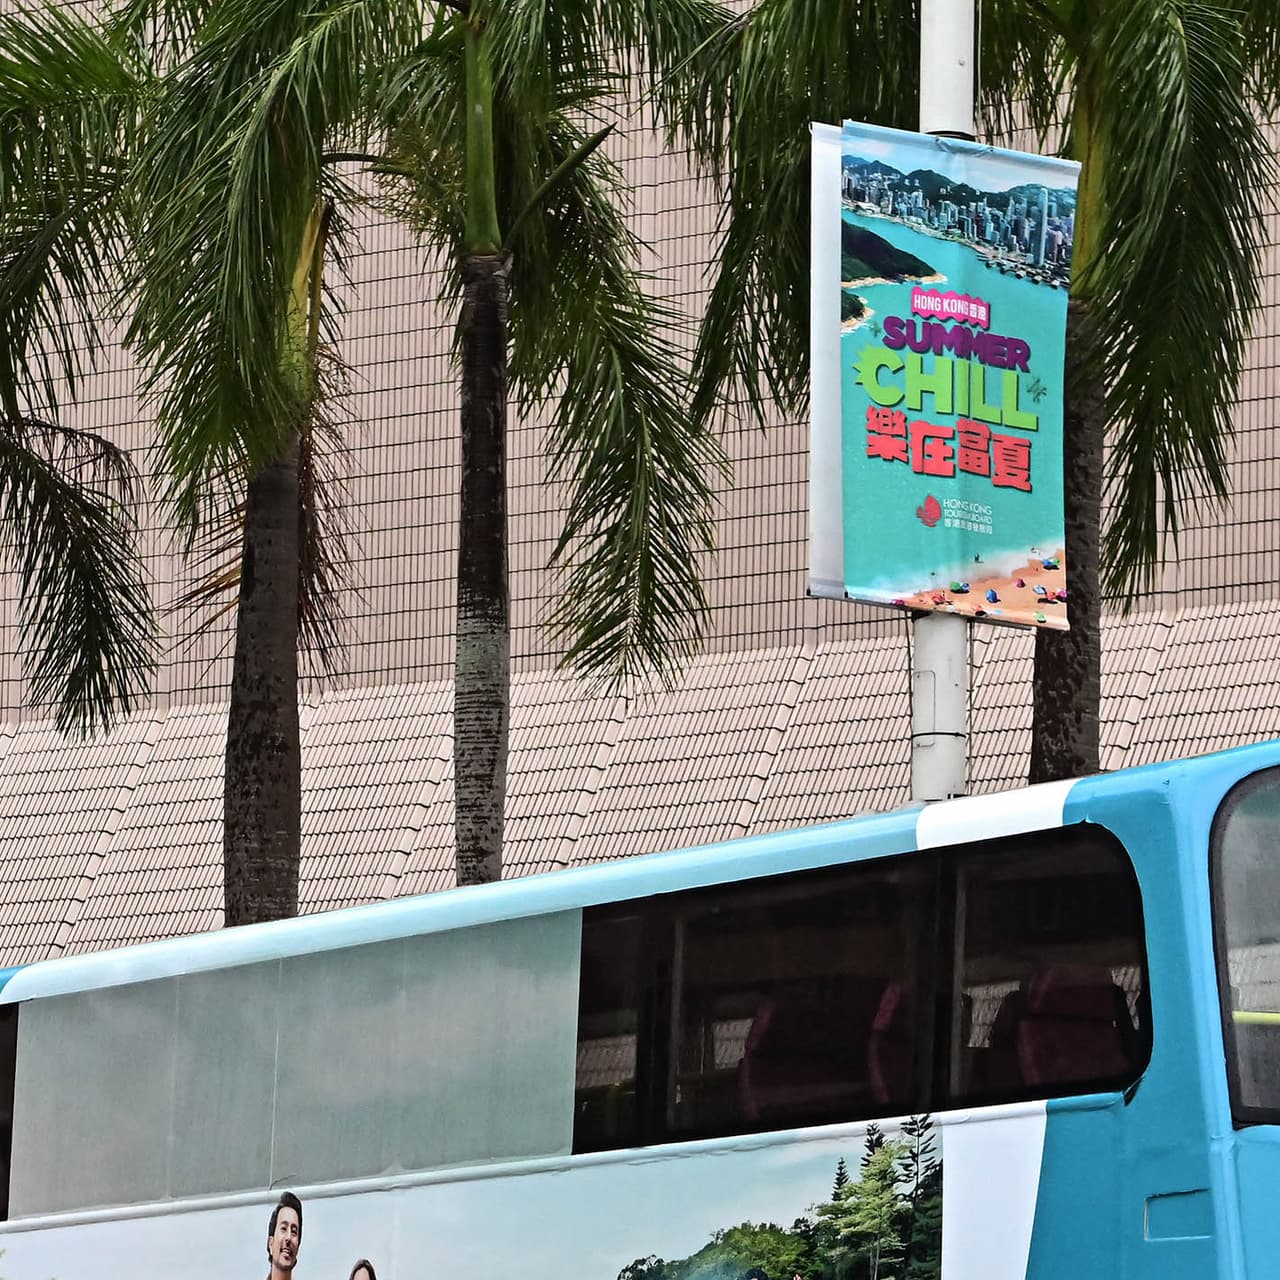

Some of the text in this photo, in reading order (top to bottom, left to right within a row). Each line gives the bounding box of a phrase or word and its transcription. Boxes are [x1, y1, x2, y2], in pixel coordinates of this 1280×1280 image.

[914, 294, 941, 311] HONG
[943, 298, 969, 315] KONG
[882, 316, 1030, 373] SUMMER
[853, 344, 1039, 432] CHILL
[943, 499, 969, 511] HONG
